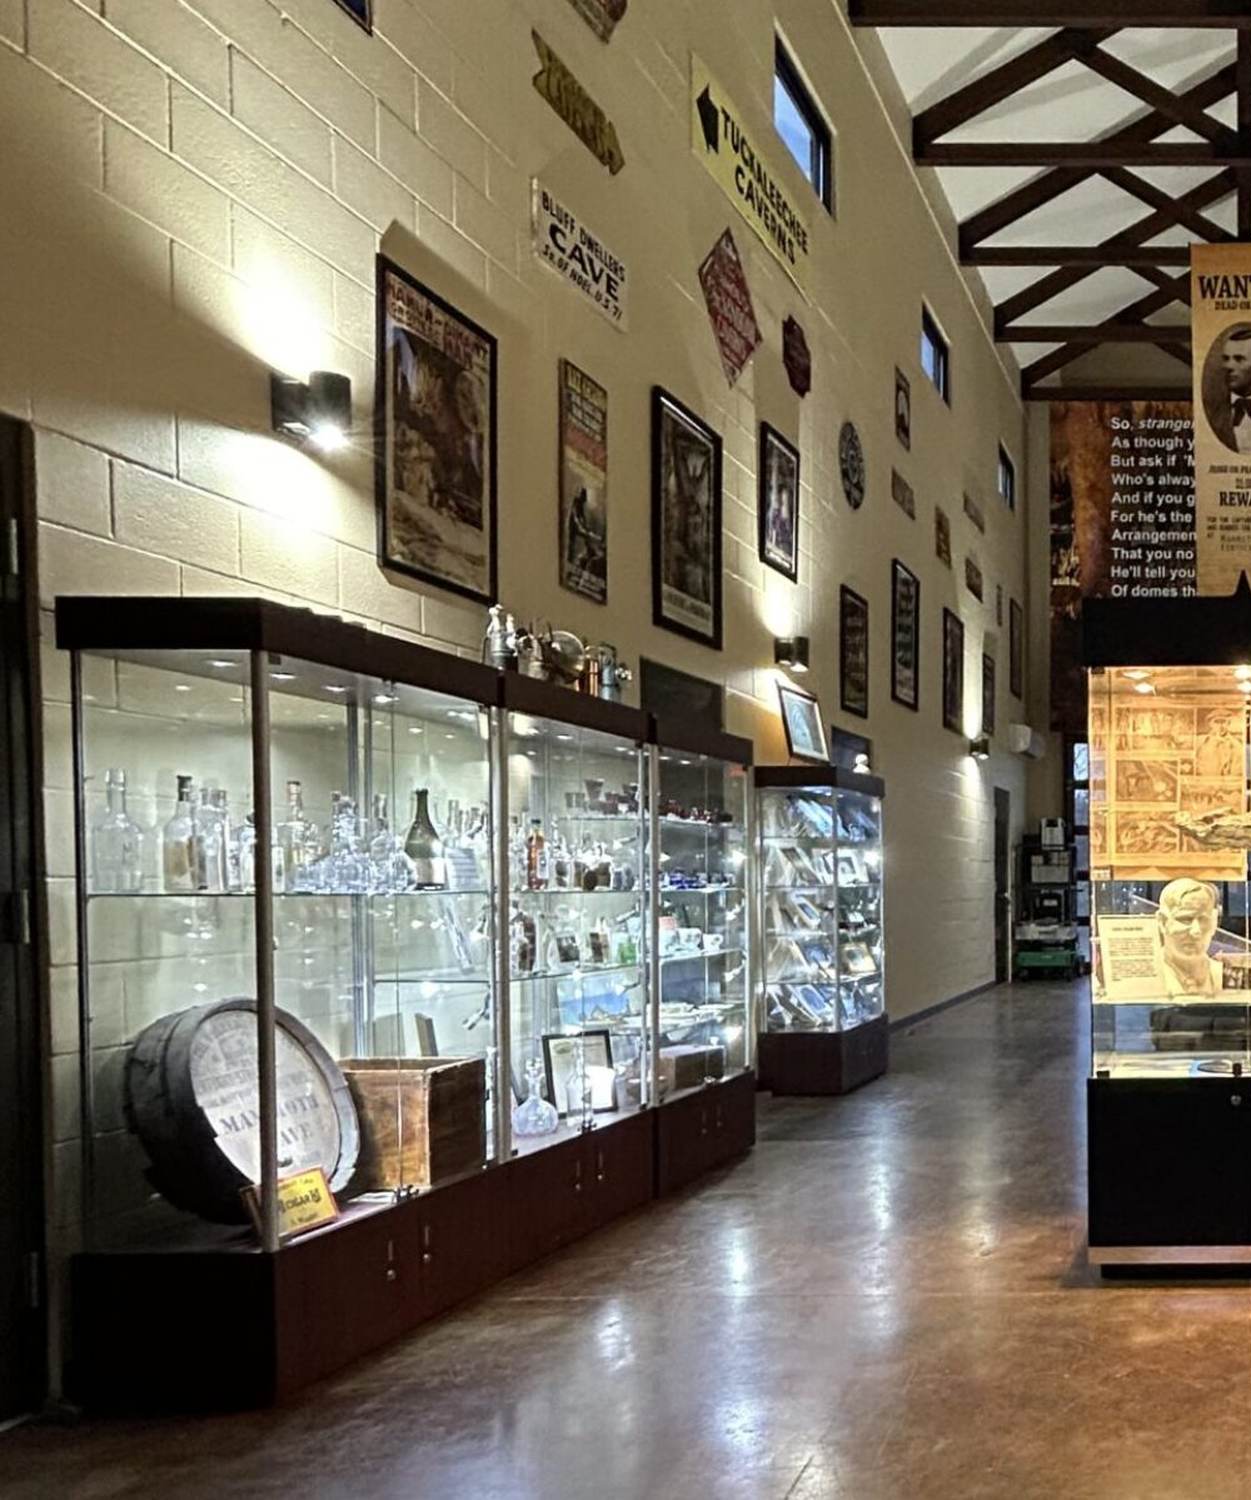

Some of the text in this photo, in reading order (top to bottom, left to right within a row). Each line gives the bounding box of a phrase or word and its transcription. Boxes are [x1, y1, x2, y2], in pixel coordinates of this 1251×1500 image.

[735, 165, 795, 265] CAVERNS
[542, 190, 625, 282] BLUFF DWELLERS
[549, 223, 619, 302] CAVE
[1215, 301, 1238, 311] DEAD
[1240, 301, 1251, 311] OR
[1111, 417, 1134, 431] So,
[1138, 418, 1194, 432] strange
[1111, 436, 1130, 449] As
[1133, 436, 1184, 451] though
[1110, 454, 1135, 467] But
[1138, 455, 1163, 467] ask
[1166, 454, 1177, 467] if
[1111, 473, 1155, 486] Who's
[1158, 474, 1195, 489] alway
[1111, 491, 1140, 504] And
[1143, 491, 1154, 504] if
[1156, 494, 1183, 507] you
[1110, 510, 1135, 523] For
[1138, 510, 1167, 523] he's
[1170, 510, 1193, 523] the
[1111, 528, 1197, 544] Arrangemen
[1110, 547, 1143, 560] That
[1145, 550, 1172, 563] you
[1175, 550, 1195, 560] no
[1110, 566, 1196, 581] He'll tell you
[1111, 584, 1129, 598] Of
[1131, 585, 1178, 598] domes
[219, 1095, 319, 1135] MAOTH
[279, 1122, 313, 1146] AVE
